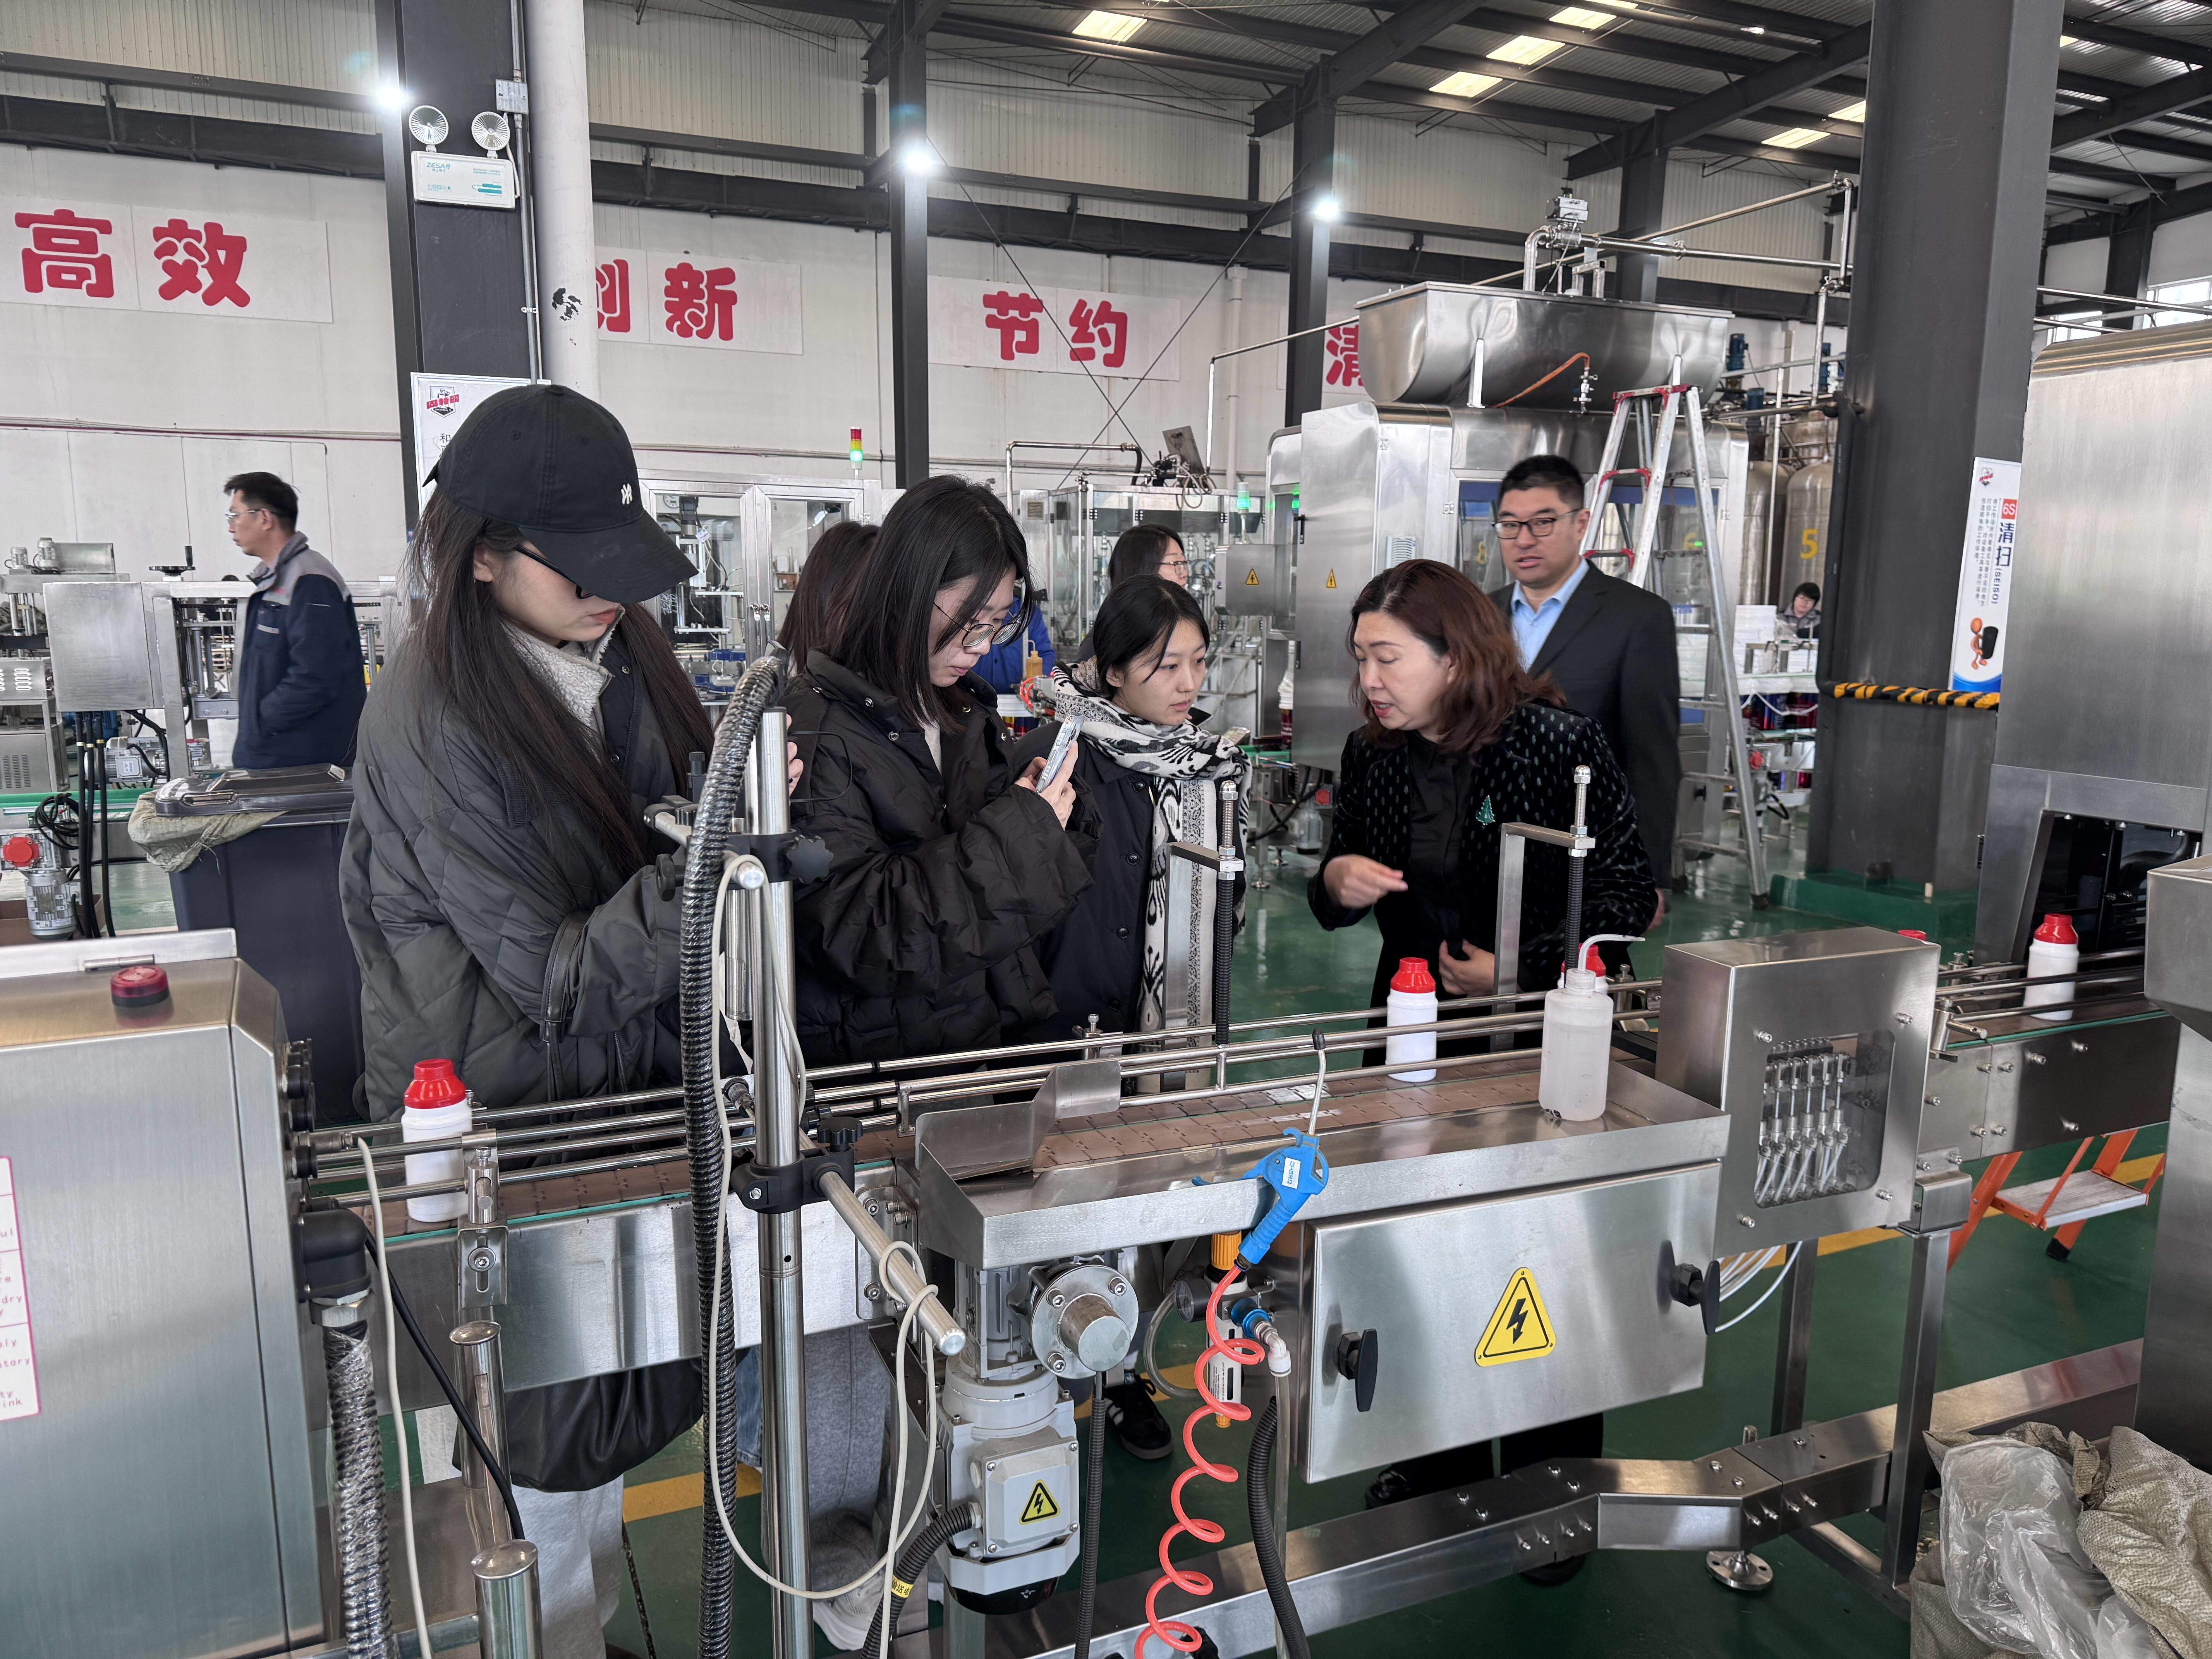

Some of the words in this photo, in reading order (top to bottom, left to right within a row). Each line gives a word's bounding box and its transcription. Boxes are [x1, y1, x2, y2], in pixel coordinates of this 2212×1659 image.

[14, 209, 251, 307] 高效
[982, 290, 1128, 368] 节约
[2003, 503, 2016, 515] 6S
[1801, 529, 1818, 559] 5
[1996, 522, 2015, 566] 清扫
